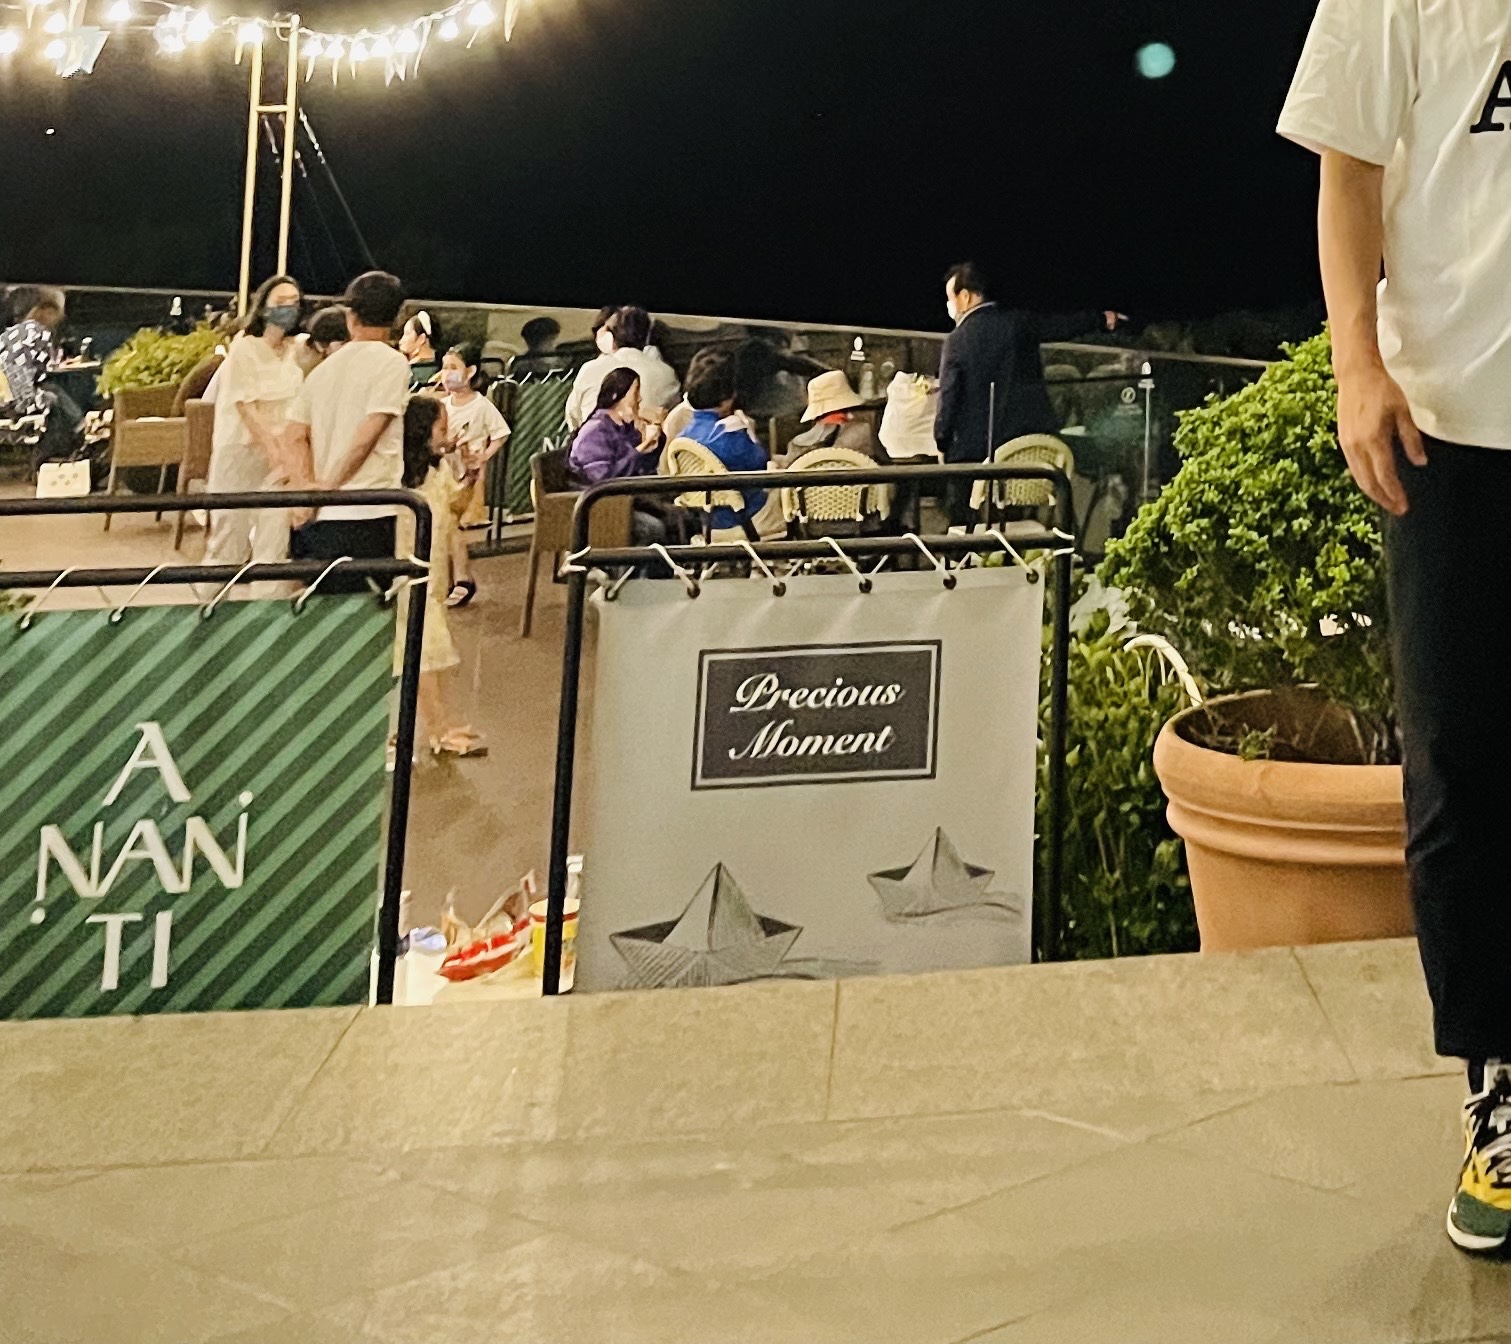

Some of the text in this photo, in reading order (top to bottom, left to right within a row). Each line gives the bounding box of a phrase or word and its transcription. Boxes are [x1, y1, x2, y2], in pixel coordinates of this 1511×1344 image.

[729, 671, 906, 713] Precious
[102, 721, 192, 806] A
[728, 718, 896, 761] Moment
[85, 909, 174, 992] TI
